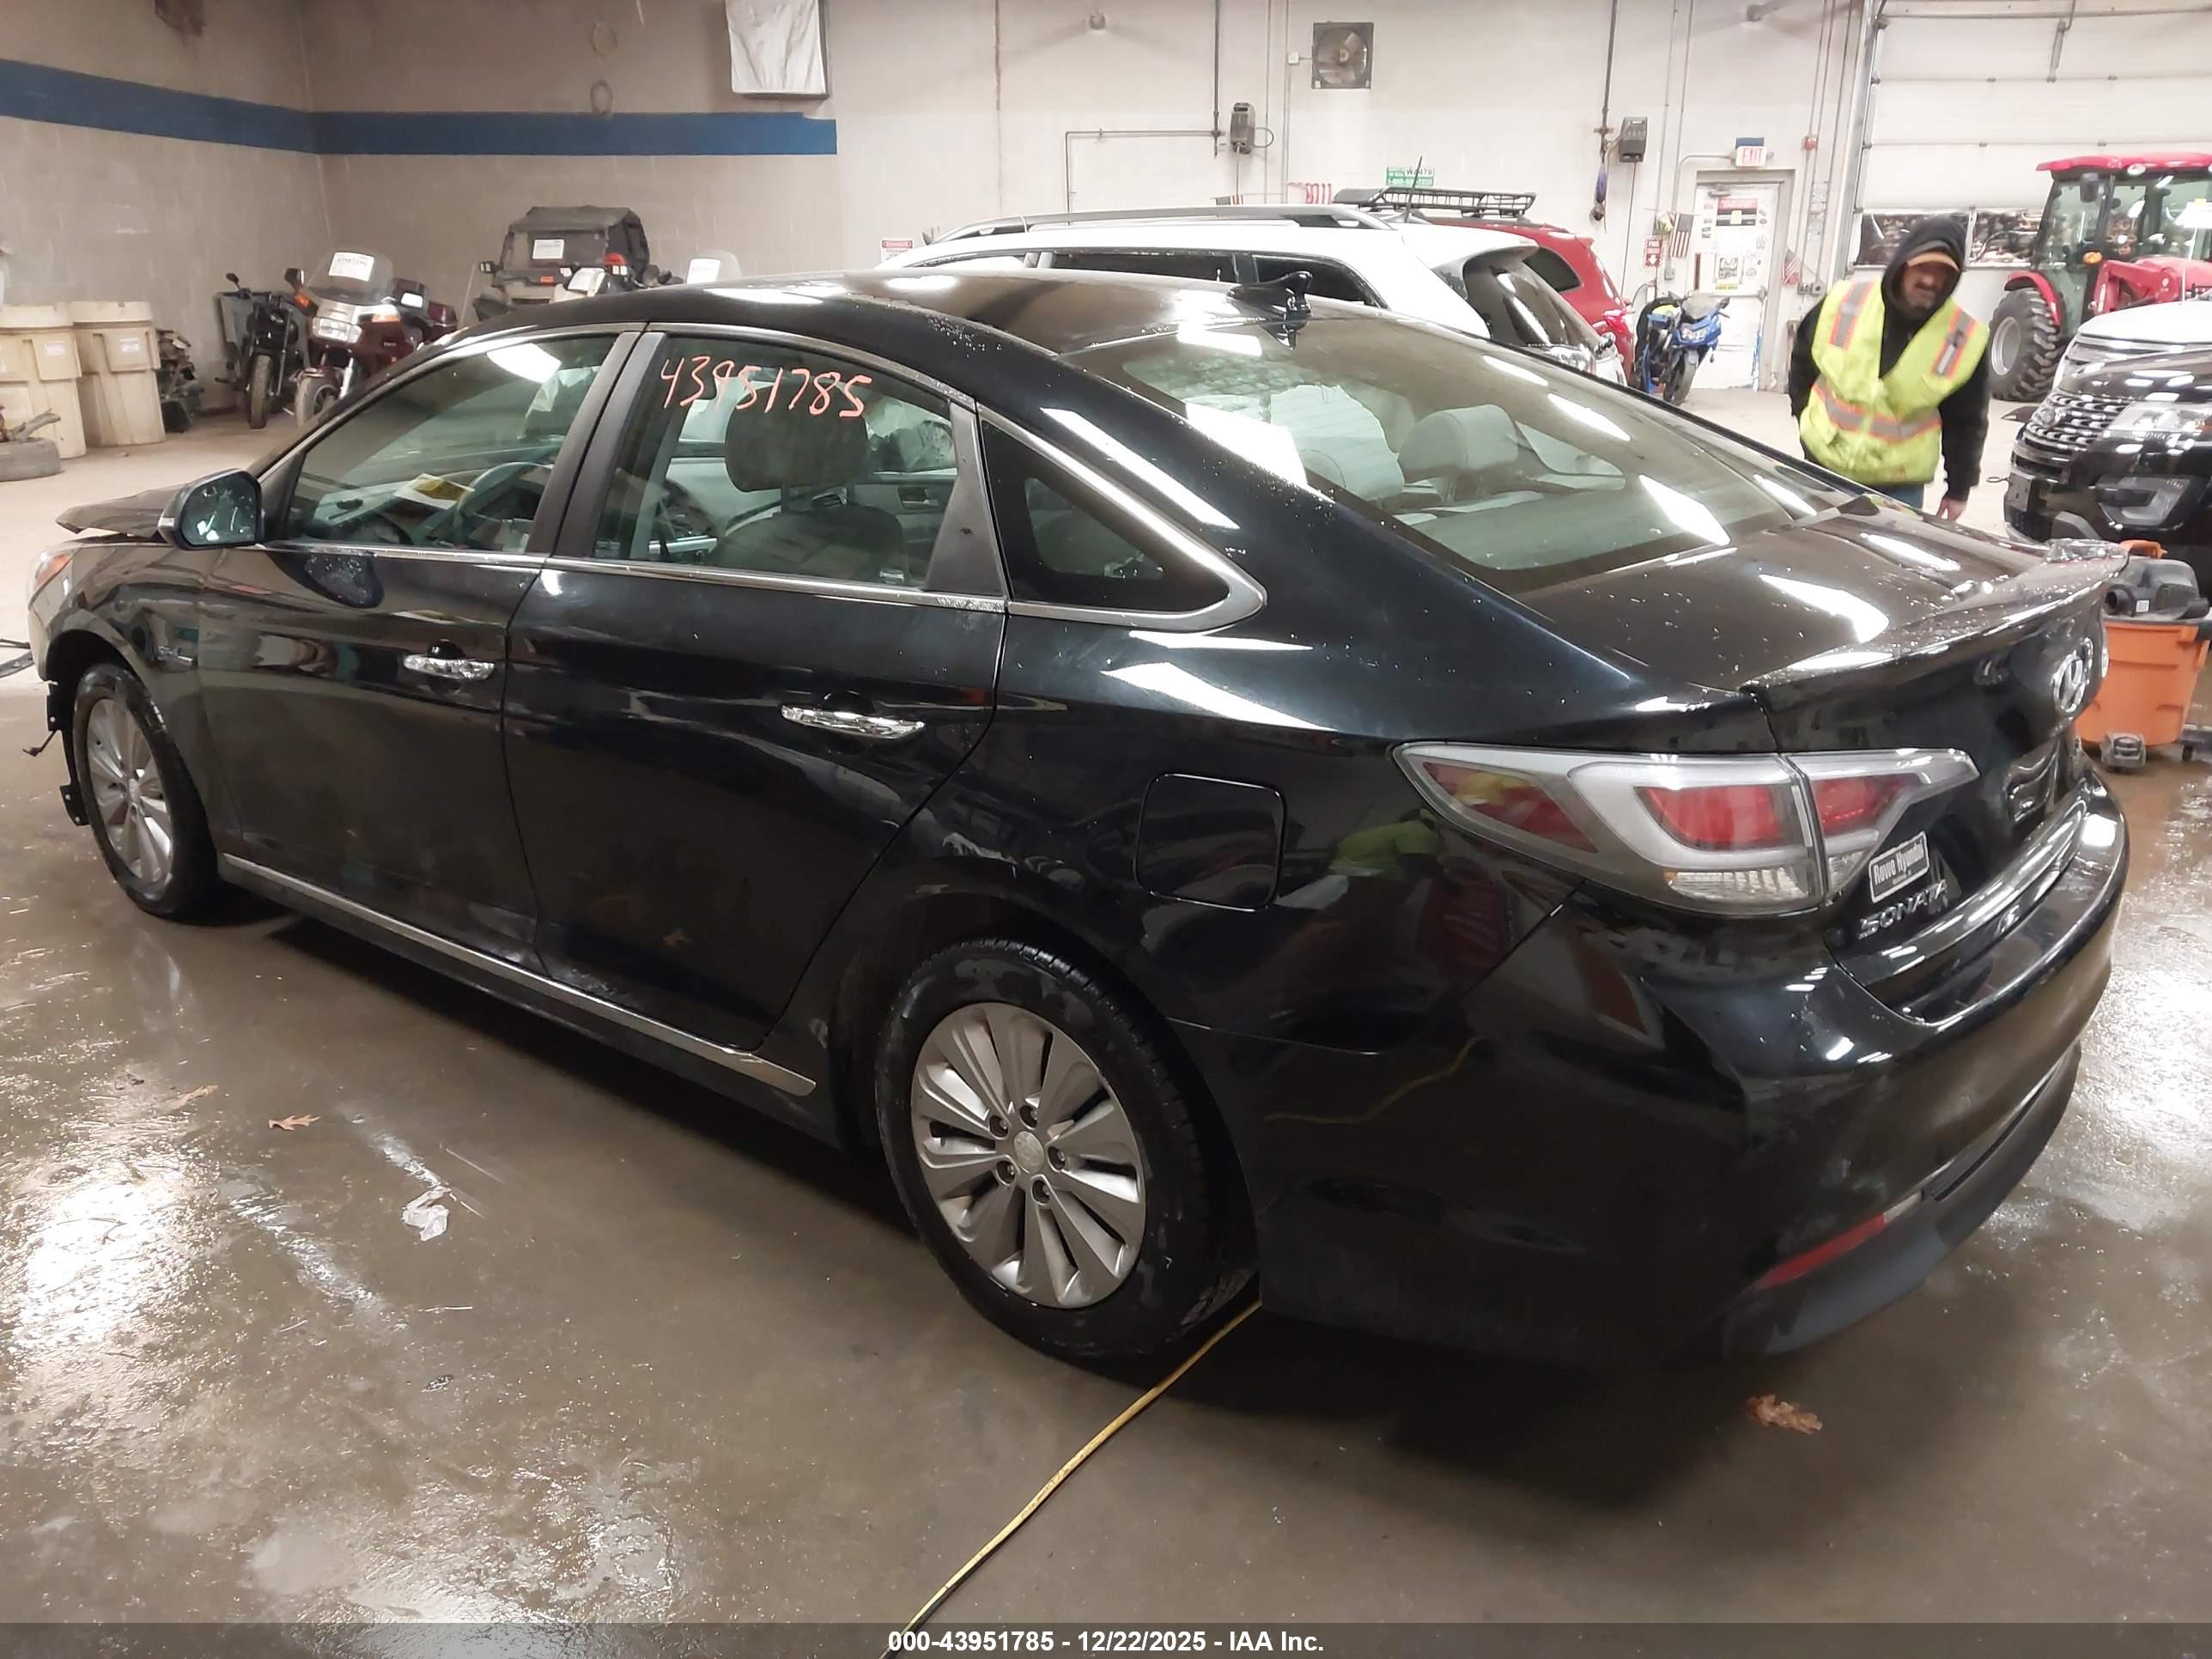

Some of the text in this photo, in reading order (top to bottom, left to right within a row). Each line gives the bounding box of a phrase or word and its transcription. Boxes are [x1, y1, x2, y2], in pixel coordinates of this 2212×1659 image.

[1742, 147, 1763, 165] EXIT
[659, 356, 873, 418] 43951785
[1858, 878, 1948, 940] SONATA
